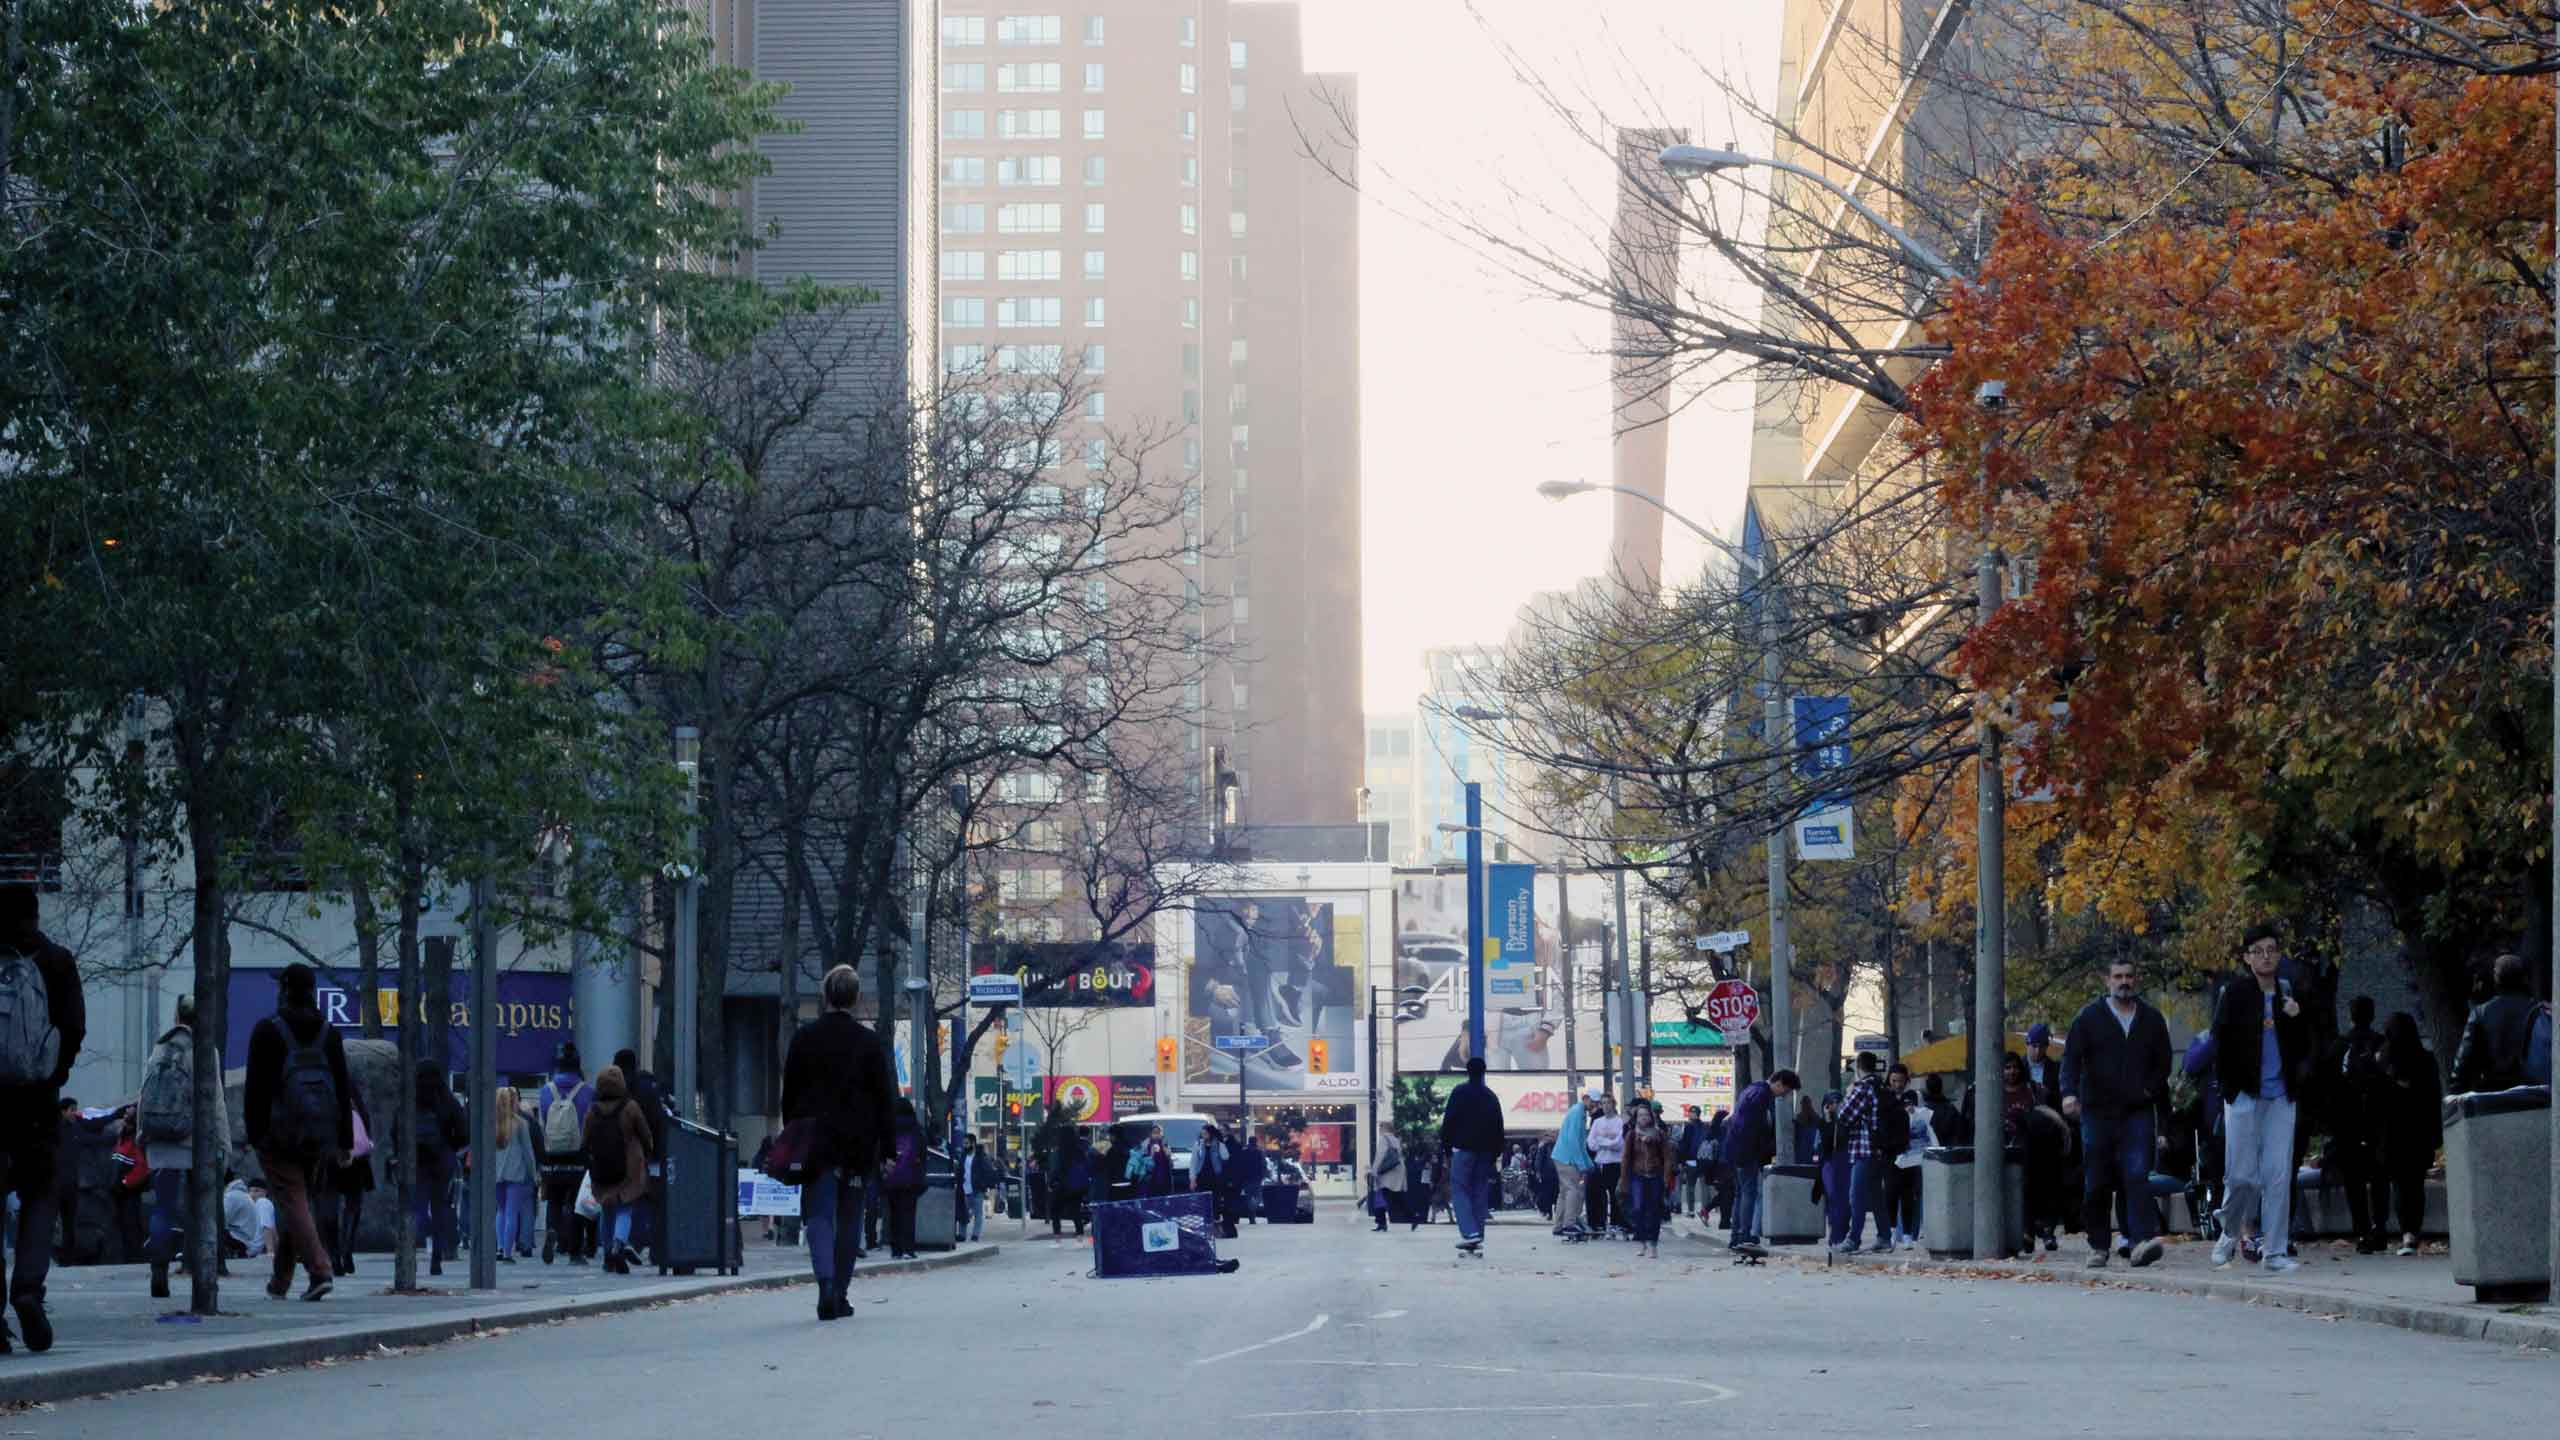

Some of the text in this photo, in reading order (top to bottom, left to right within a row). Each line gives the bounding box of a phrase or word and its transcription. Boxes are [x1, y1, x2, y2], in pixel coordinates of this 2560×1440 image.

[1506, 899, 1518, 952] Ryerson
[1517, 887, 1530, 952] University
[1079, 968, 1136, 991] BOUT
[1710, 995, 1754, 1018] STOP
[1317, 1078, 1360, 1087] ALDO
